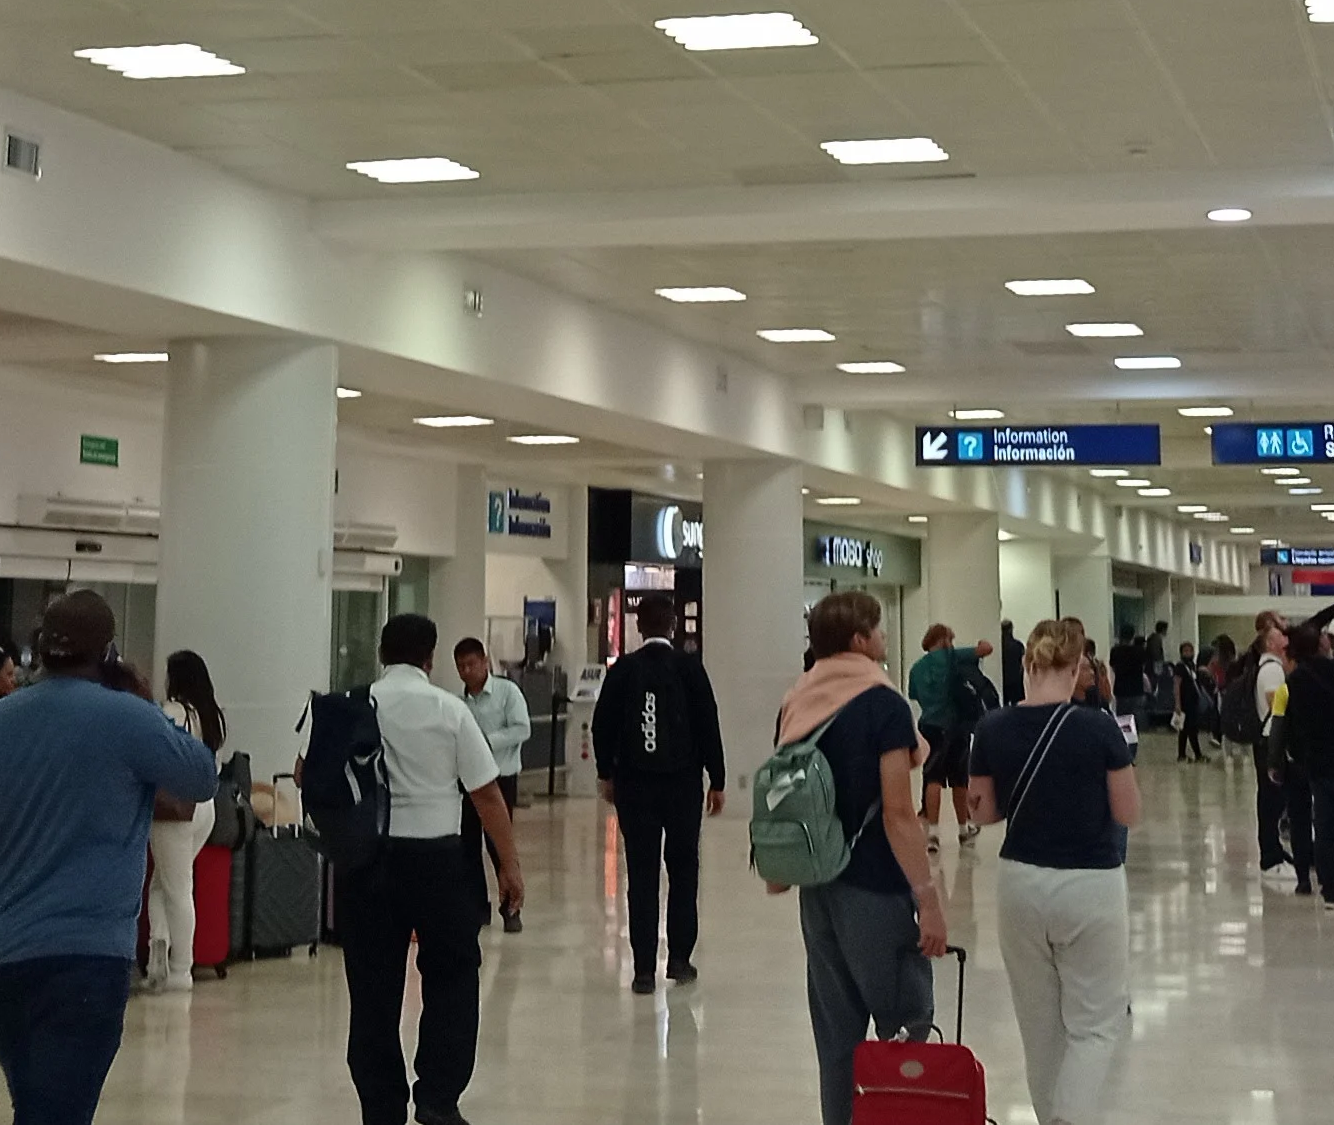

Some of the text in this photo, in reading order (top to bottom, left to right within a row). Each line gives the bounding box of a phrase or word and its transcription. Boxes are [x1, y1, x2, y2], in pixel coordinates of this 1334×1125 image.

[993, 428, 1068, 444] Information
[993, 443, 1075, 461] Información
[644, 691, 656, 753] adidas
